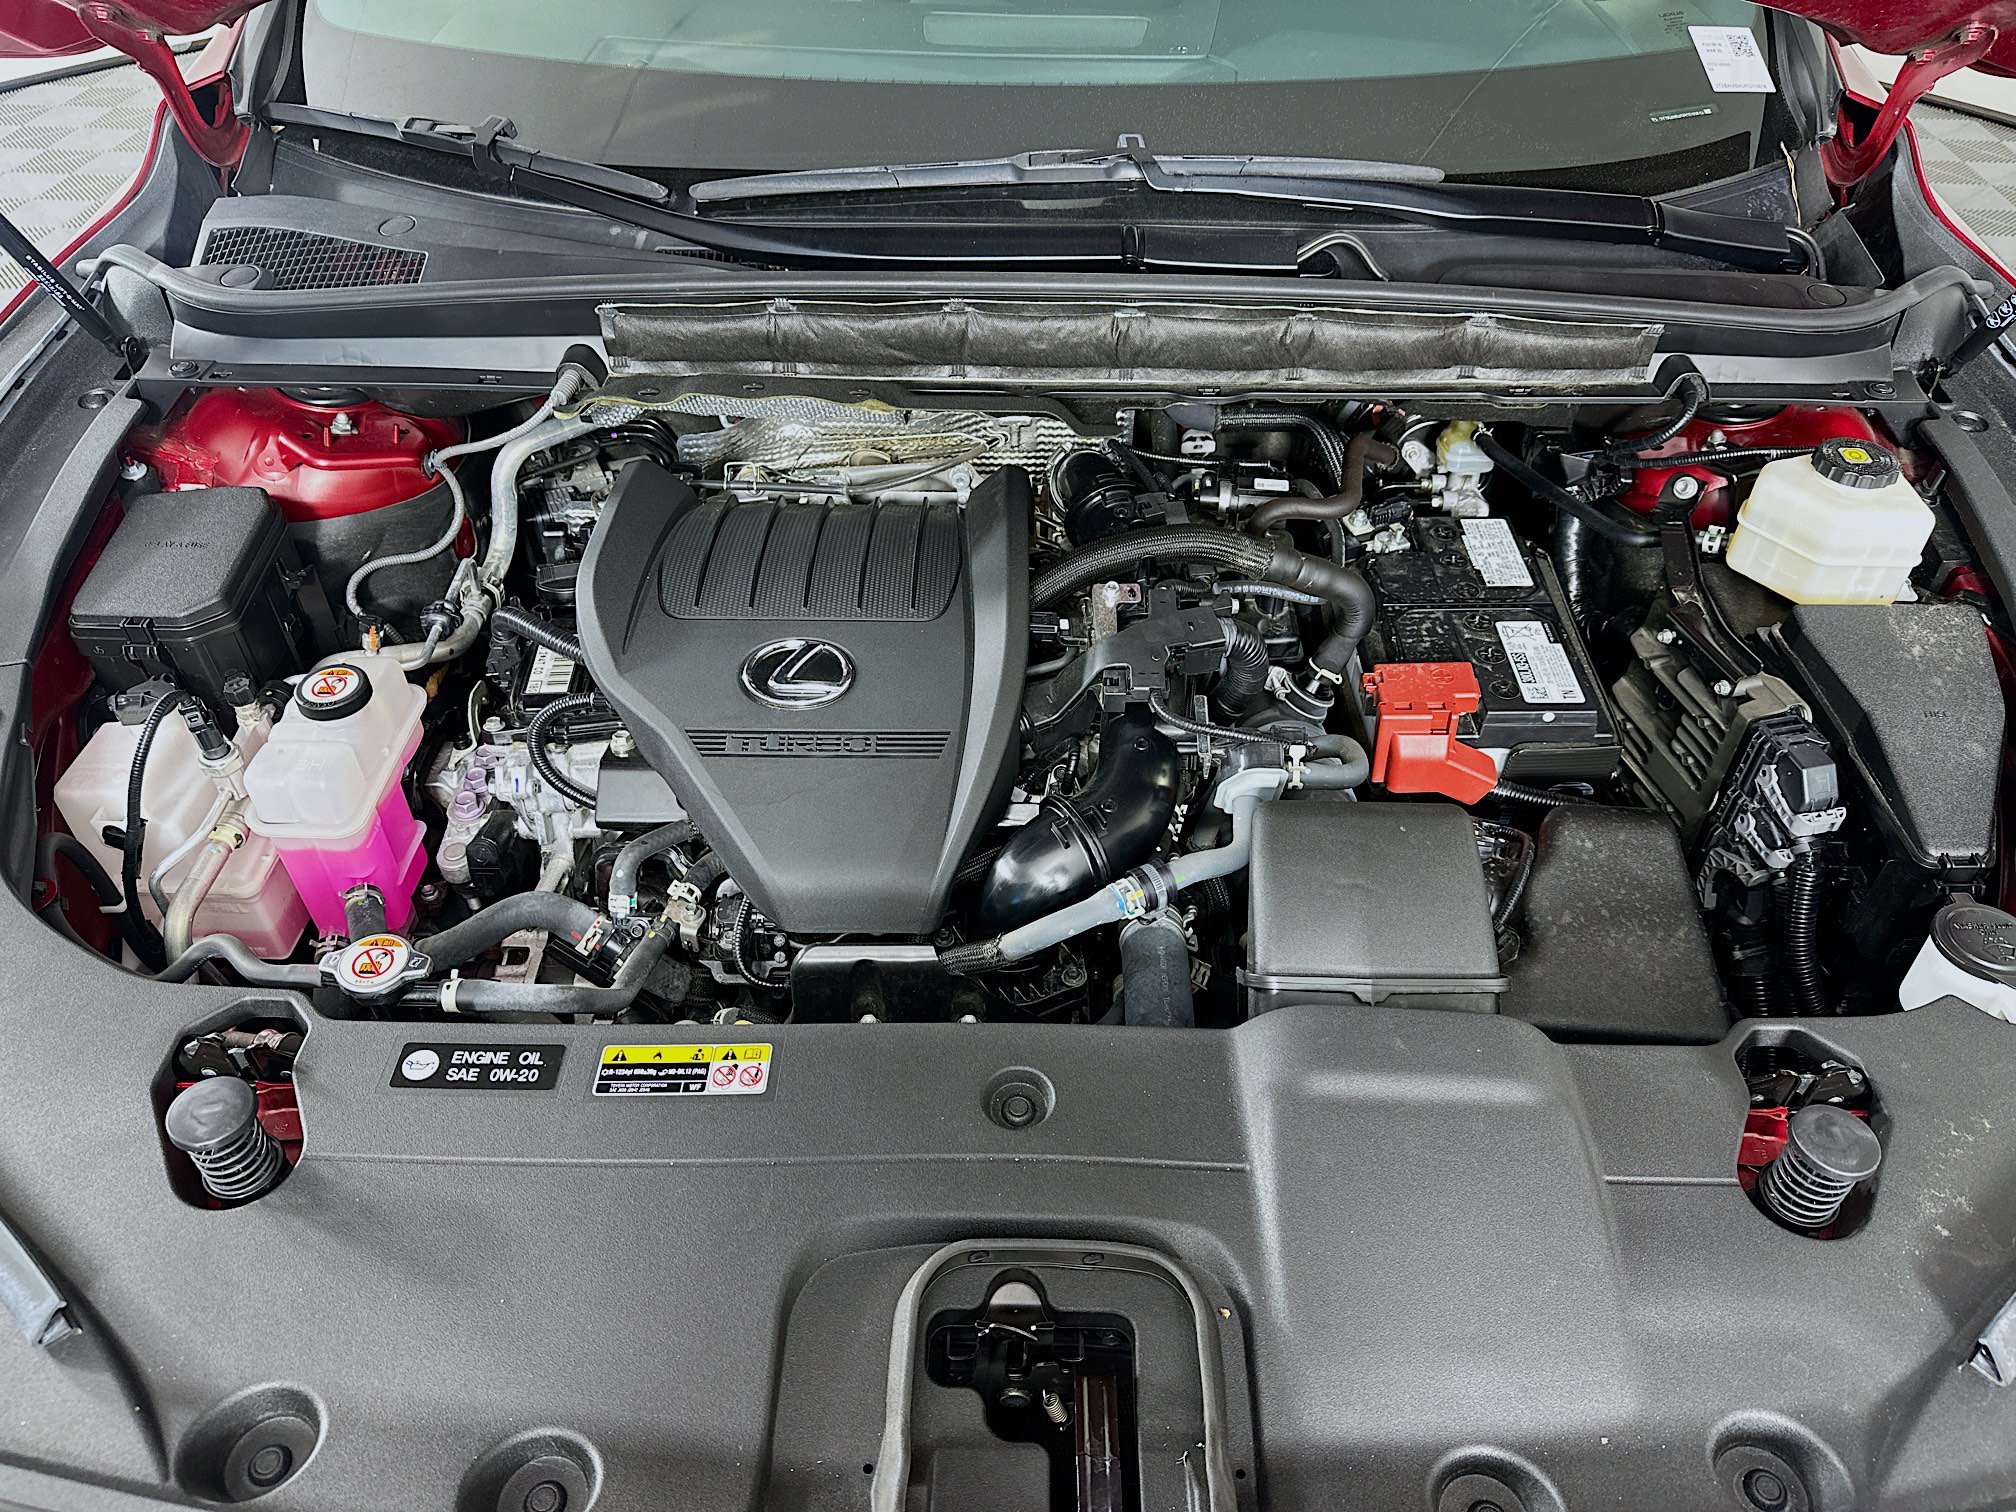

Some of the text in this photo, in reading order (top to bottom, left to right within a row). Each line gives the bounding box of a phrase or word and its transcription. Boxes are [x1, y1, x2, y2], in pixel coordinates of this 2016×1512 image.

[730, 734, 873, 753] TURBO
[450, 1051, 544, 1065] ENGINE OIL
[445, 1068, 539, 1082] SAE 0W-20
